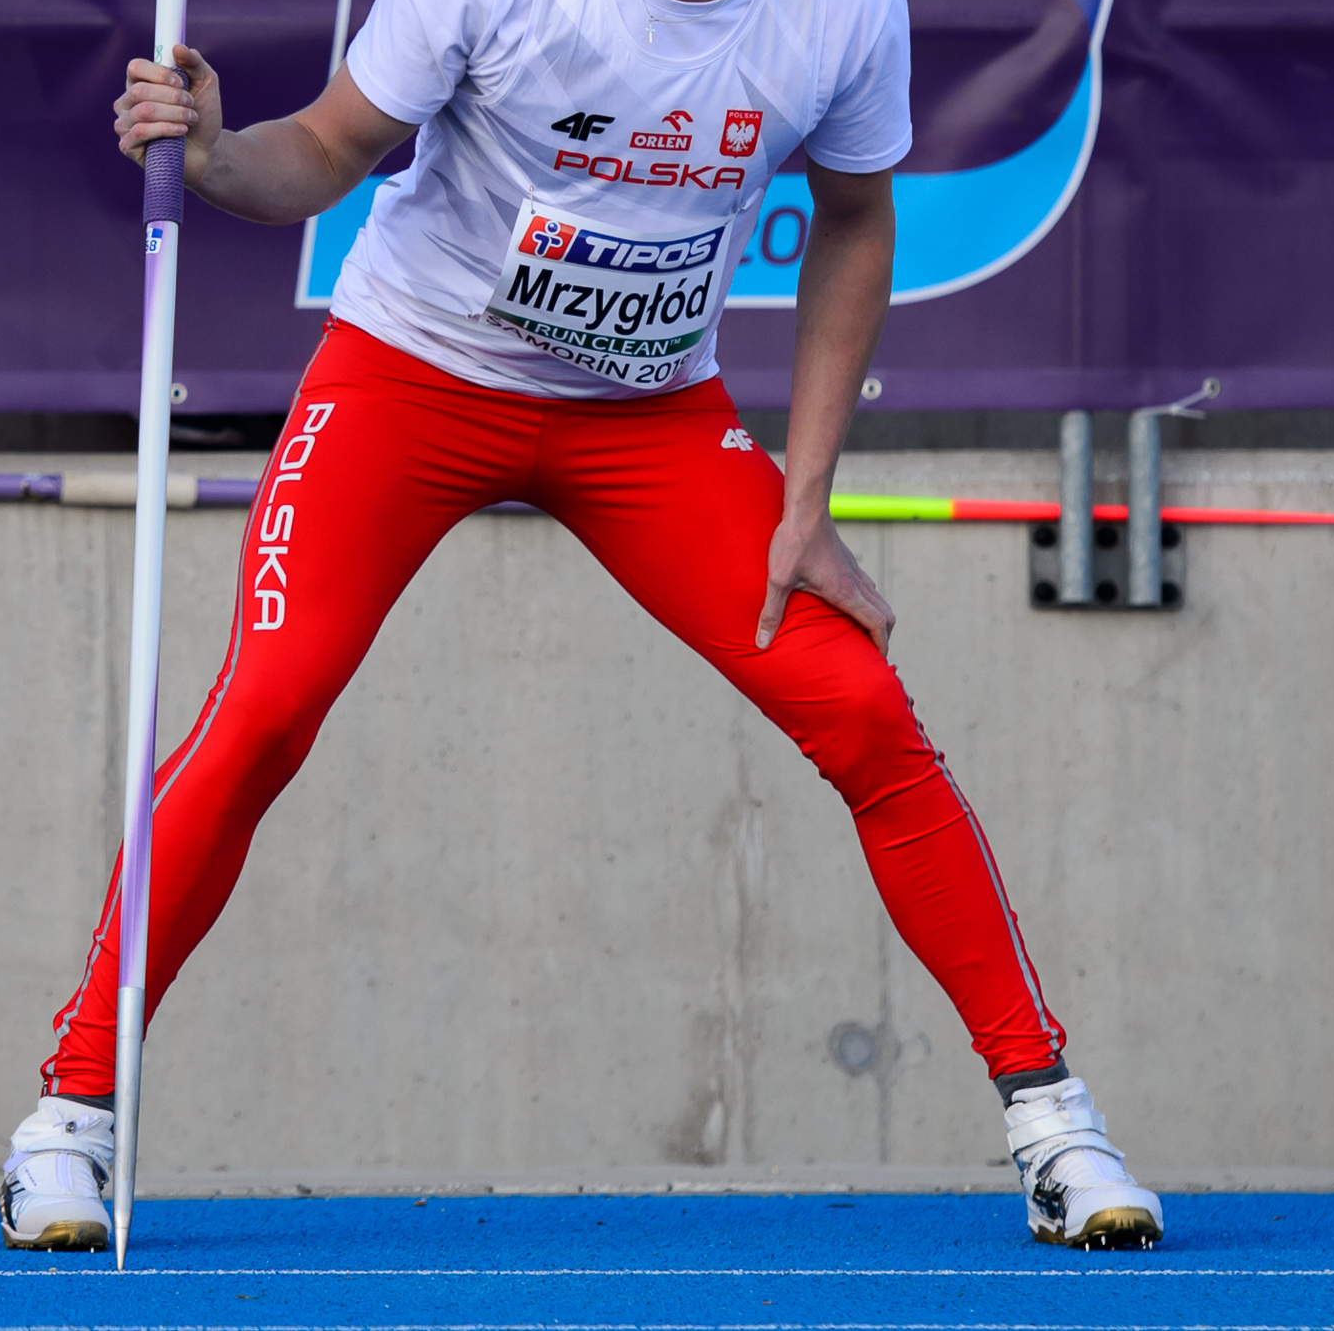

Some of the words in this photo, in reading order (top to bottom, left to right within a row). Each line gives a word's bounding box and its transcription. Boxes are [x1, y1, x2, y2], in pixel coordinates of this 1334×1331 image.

[551, 111, 616, 141] 4F
[728, 111, 760, 120] POLSKA
[633, 134, 688, 150] ORLEN
[553, 149, 745, 190] POLSKA
[584, 232, 716, 270] TIPOS
[506, 263, 714, 336] Mrzygłód
[522, 319, 531, 330] I
[534, 323, 587, 347] RUN
[252, 402, 336, 631] POLSKA
